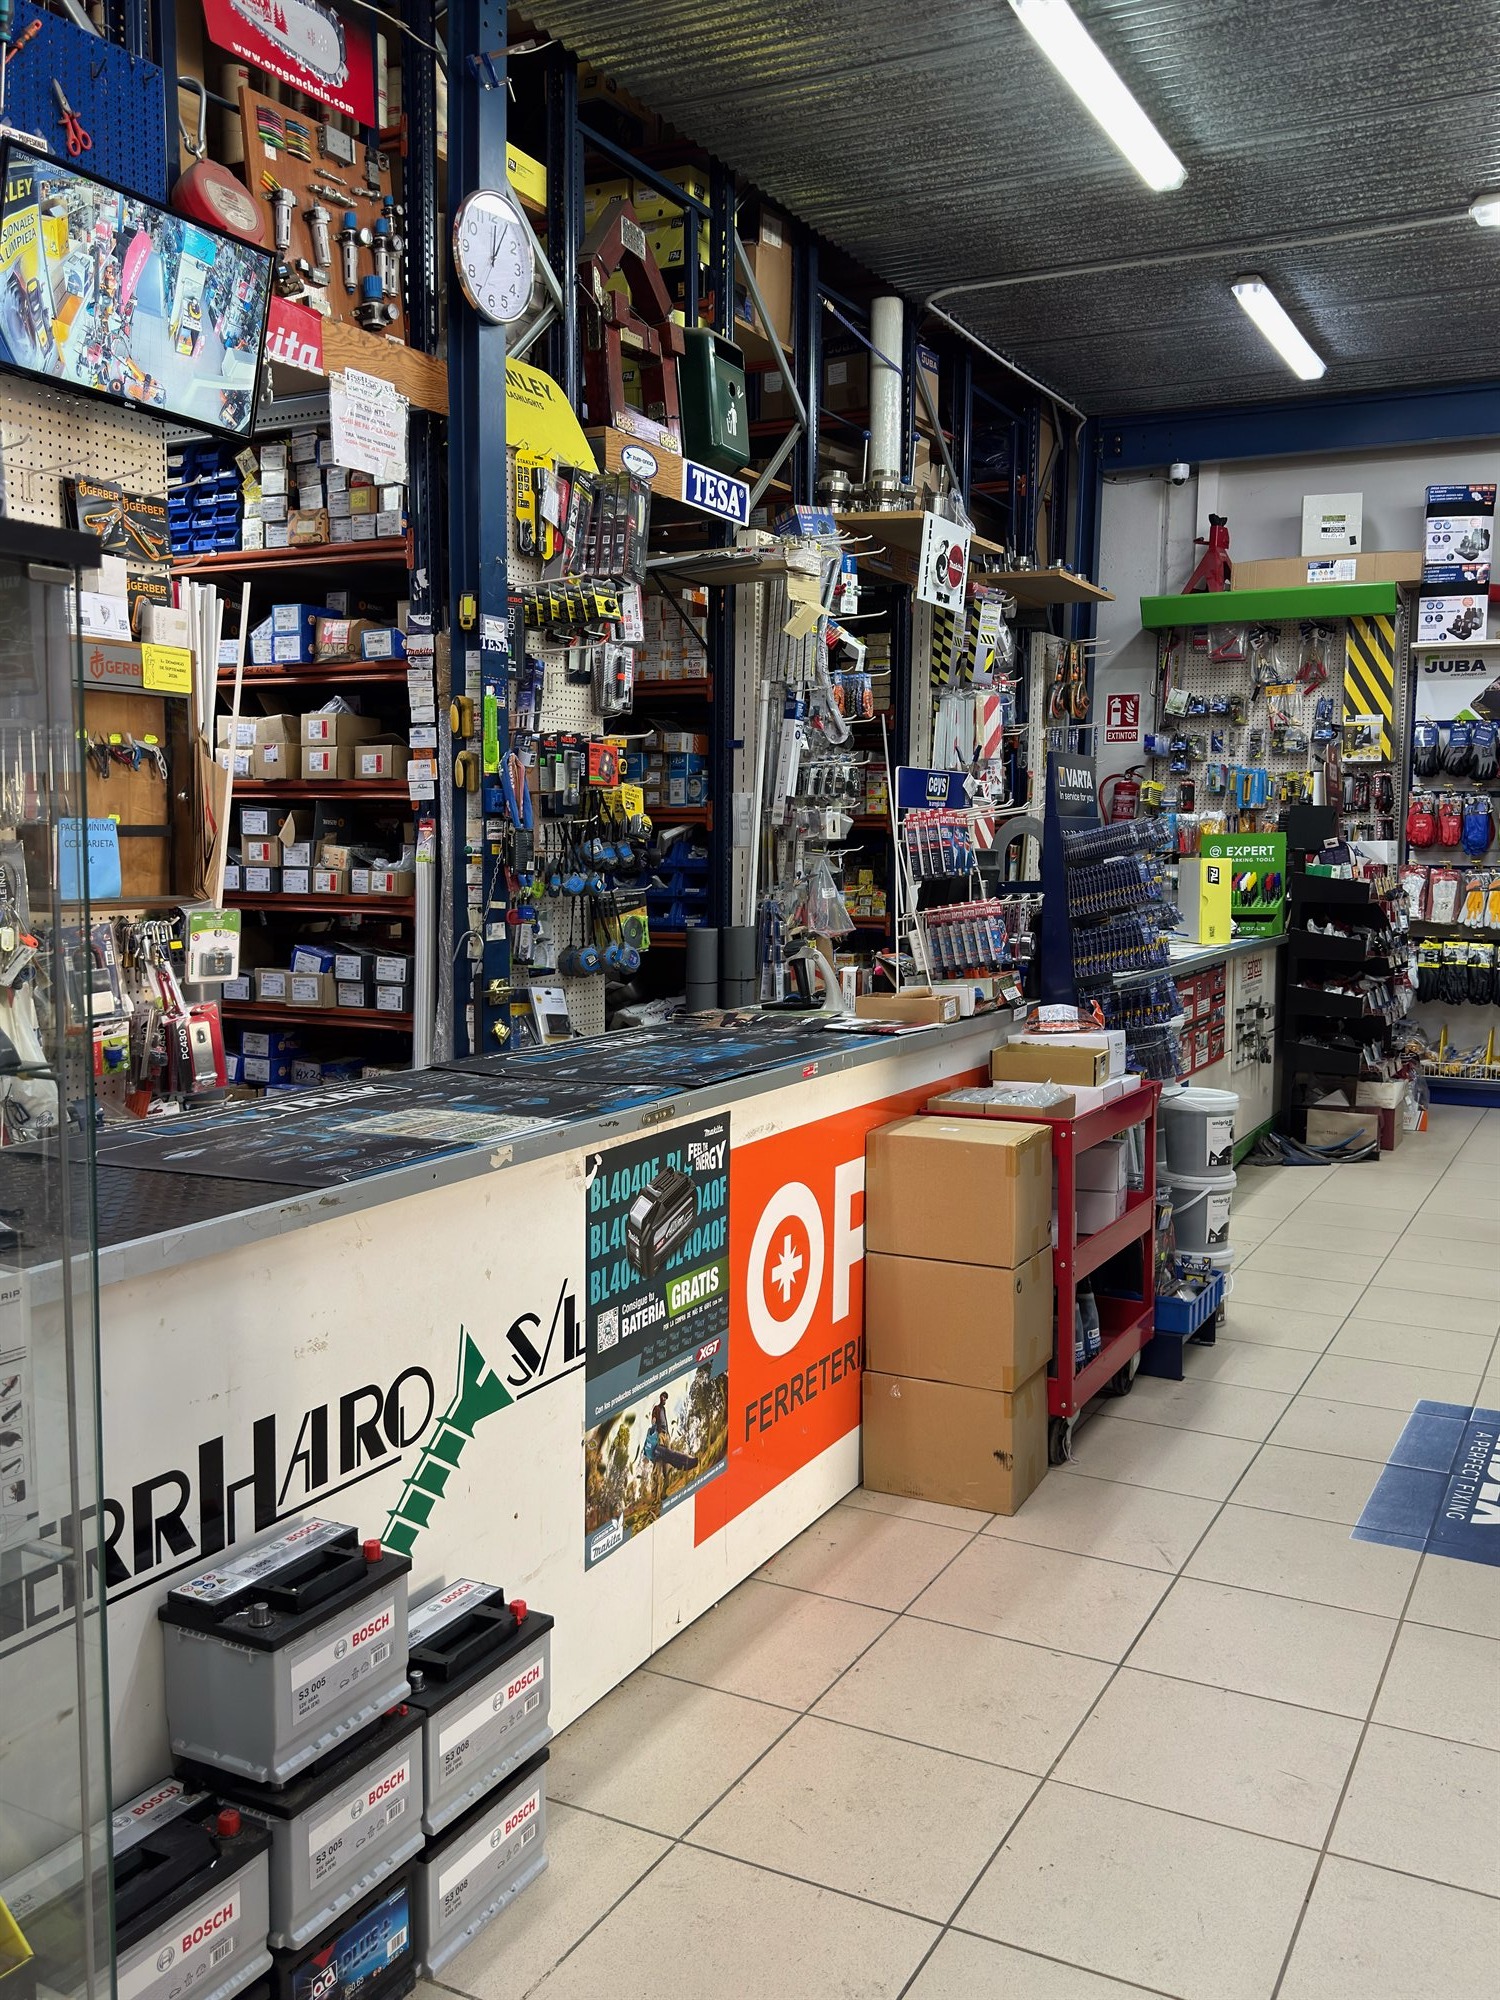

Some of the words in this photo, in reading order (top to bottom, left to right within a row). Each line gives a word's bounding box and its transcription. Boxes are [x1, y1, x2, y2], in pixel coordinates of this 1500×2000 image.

[232, 42, 355, 115] www.oregonchain.com
[467, 220, 478, 236] 10
[462, 239, 469, 252] 9
[510, 242, 517, 255] 2
[468, 264, 477, 278] 8
[514, 263, 521, 277] 3
[475, 284, 483, 297] 7
[509, 284, 517, 296] 4
[488, 295, 495, 308] 6
[501, 295, 508, 309] 5
[87, 486, 119, 501] GERBER
[129, 502, 165, 516] GERBER
[131, 580, 166, 594] GERBER
[480, 634, 508, 652] TESA
[106, 660, 143, 676] GERB
[1424, 660, 1486, 673] JUBA
[561, 736, 577, 744] NEBO
[1107, 731, 1138, 742] EXTINTOR
[928, 777, 947, 796] ceys
[1066, 768, 1093, 789] VARTA
[1060, 791, 1064, 800] In
[1065, 792, 1079, 801] service
[1086, 795, 1094, 804] you
[87, 840, 114, 848] ARJETA
[1227, 846, 1275, 856] EXPERT
[1210, 867, 1218, 883] FAL
[178, 1028, 190, 1060] PC430
[688, 1142, 703, 1162] FEEL
[696, 1140, 727, 1171] ENERGY
[1182, 1262, 1210, 1271] VARTA
[671, 1267, 719, 1310] GRATIS
[622, 1295, 648, 1315] Consigue
[649, 1292, 655, 1302] tu
[622, 1297, 666, 1338] BATERÍA
[699, 1340, 720, 1361] XGT
[595, 1406, 604, 1415] Con
[611, 1390, 632, 1408] productos
[632, 1374, 659, 1393] seleccionados
[659, 1368, 668, 1380] para
[669, 1355, 694, 1374] profesionales
[1461, 1440, 1490, 1482] PERFECT
[1445, 1483, 1475, 1520] FIXING
[286, 1521, 324, 1542] BOSCH
[440, 1583, 474, 1605] BOSCH
[352, 1612, 390, 1648] BOSCH
[299, 1689, 310, 1701] S3
[311, 1676, 327, 1694] 005
[508, 1666, 540, 1700] BOSCH
[445, 1750, 455, 1765] S3
[456, 1739, 470, 1756] 008
[368, 1769, 406, 1806] BOSCH
[132, 1786, 182, 1816] BOSCH
[505, 1798, 536, 1835] BOSCH
[315, 1853, 327, 1865] S3
[328, 1838, 343, 1856] 005
[445, 1892, 454, 1906] S3
[455, 1879, 468, 1897] 008
[182, 1903, 234, 1953] BOSCH
